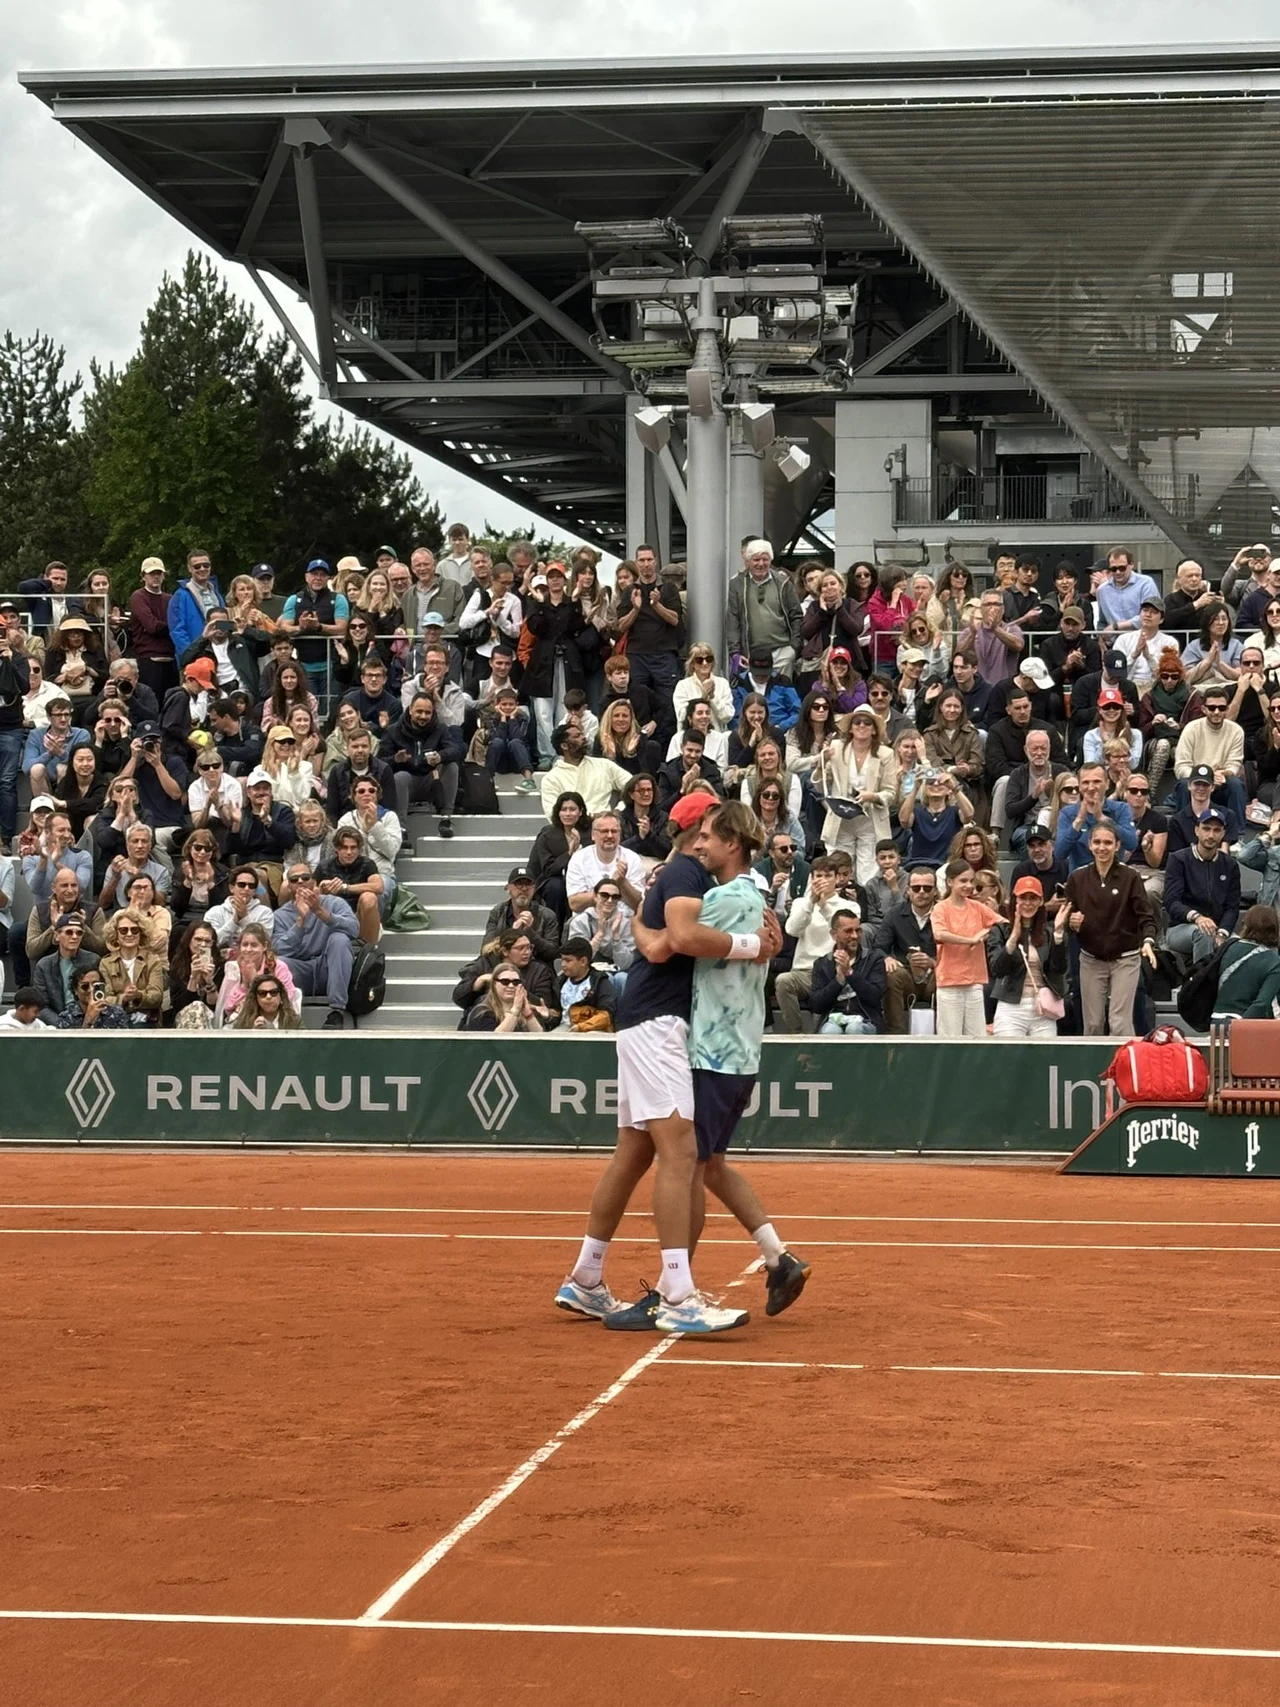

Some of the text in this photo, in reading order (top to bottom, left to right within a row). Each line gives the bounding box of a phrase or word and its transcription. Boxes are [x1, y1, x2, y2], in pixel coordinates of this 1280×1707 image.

[147, 1075, 421, 1112] RENAULT
[550, 1078, 833, 1118] RELT
[1126, 1113, 1199, 1168] perrier
